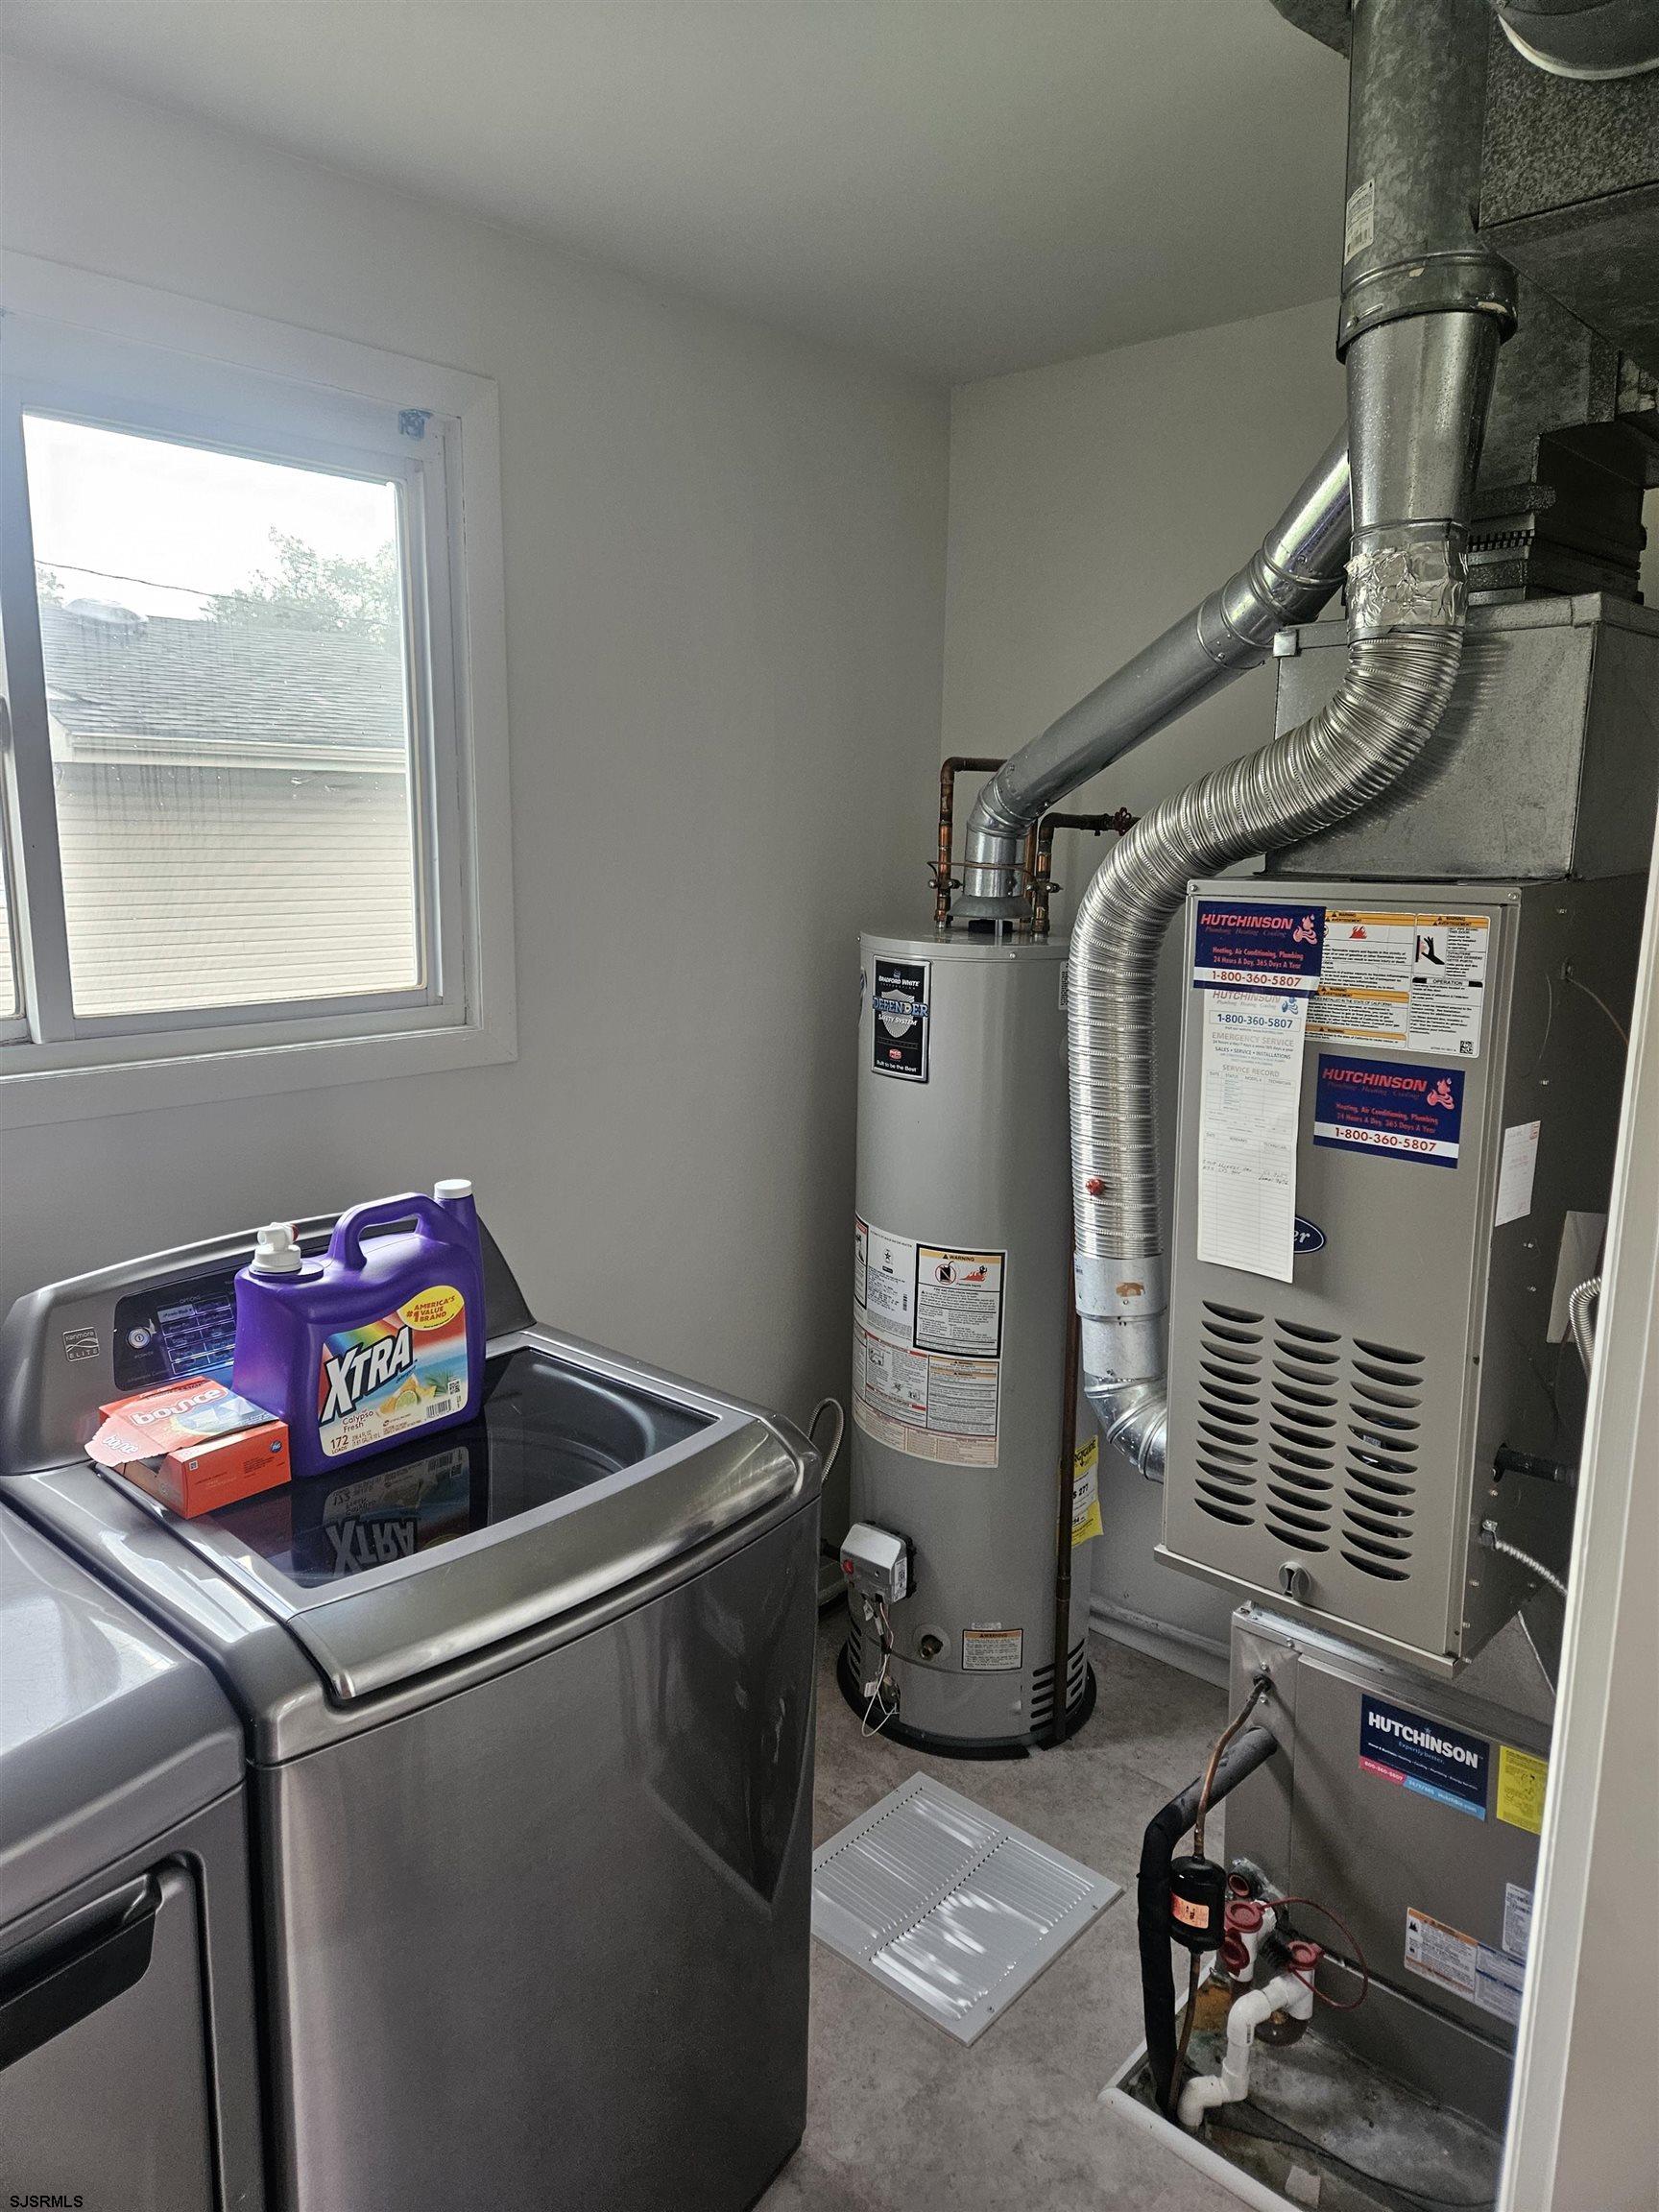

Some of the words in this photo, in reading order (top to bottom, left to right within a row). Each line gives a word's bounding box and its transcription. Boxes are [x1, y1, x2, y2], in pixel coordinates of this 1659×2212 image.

[1200, 914, 1294, 930] HUTCHINSON
[1212, 947, 1233, 956] Heating,
[1279, 951, 1304, 961] Plumbing
[1269, 960, 1282, 969] Days
[878, 975, 901, 985] BRADFORD
[902, 978, 920, 987] WHITE
[1212, 970, 1302, 987] 1-800-360-5807
[1213, 990, 1283, 1004] HUTCHINSON
[874, 998, 929, 1017] DEFENDER
[878, 1013, 894, 1022] SAFETY
[895, 1016, 918, 1026] SYSTEM
[1217, 1014, 1293, 1029] 1-800-360-5807
[1212, 1032, 1260, 1043] EMERGENCY
[1262, 1036, 1294, 1047] SERVICE
[1256, 1051, 1291, 1060] INSTALLATIONS
[1222, 1064, 1251, 1073] SERVICE
[1252, 1068, 1280, 1077] RECORD
[1322, 1068, 1428, 1092] HUTCHINSON
[1346, 1114, 1363, 1123] Hours
[1399, 1121, 1414, 1132] Days
[1422, 1125, 1436, 1134] Year
[1411, 1113, 1439, 1125] Plumbing
[1334, 1127, 1437, 1153] 1-800-360-5807
[949, 1254, 975, 1262] WARNING
[414, 1296, 455, 1311] AMERICA'S
[406, 1311, 420, 1322] #1
[420, 1311, 447, 1322] BRAND
[421, 1306, 444, 1316] VALUE
[65, 1331, 95, 1342] Kenmore
[69, 1348, 98, 1359] ELITE
[320, 1326, 412, 1424] XTRA
[132, 1387, 227, 1425] bounce
[342, 1410, 374, 1426] Calypso
[343, 1421, 364, 1434] Fresh
[103, 1434, 139, 1455] bounce
[330, 1435, 349, 1450] 172
[331, 1445, 349, 1455] LOADS
[1368, 1711, 1479, 1768] HUTCHINSON
[1398, 1741, 1423, 1760] Expertly
[1424, 1751, 1444, 1765] better.
